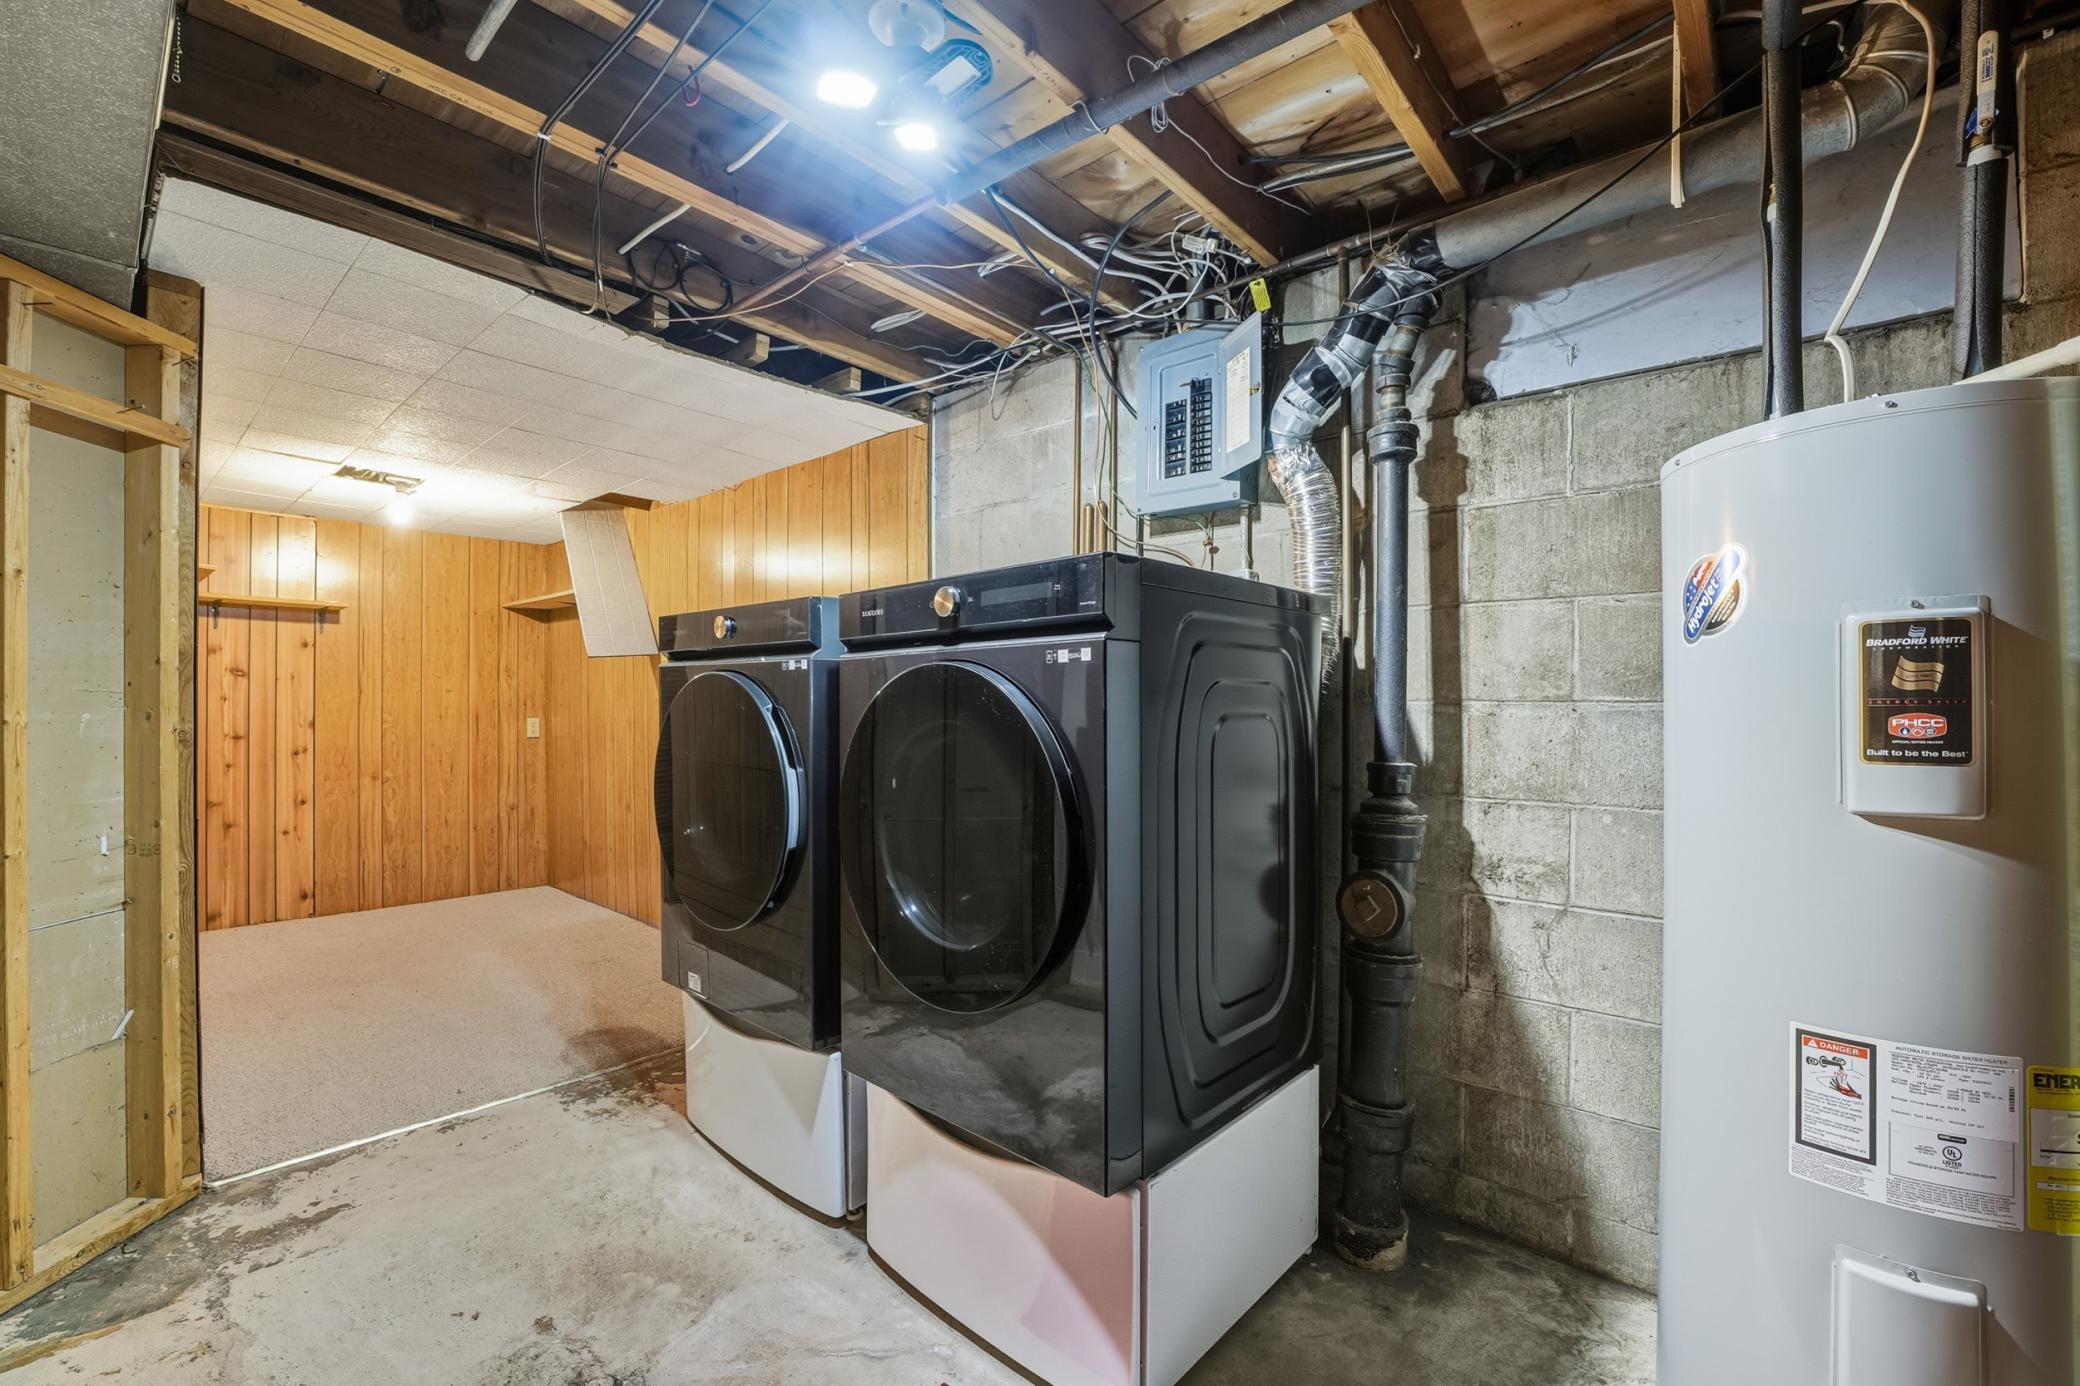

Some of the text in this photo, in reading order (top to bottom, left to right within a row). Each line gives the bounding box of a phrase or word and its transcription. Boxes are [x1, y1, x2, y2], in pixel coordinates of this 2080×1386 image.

[1687, 577, 1719, 633] Hydrojet
[1866, 636, 1968, 647] BRADFORD WHITE
[1892, 718, 1944, 727] PHCC
[1866, 748, 1889, 756] Built
[1891, 749, 1903, 757] to
[1905, 749, 1919, 757] be
[1921, 749, 1939, 757] the
[1820, 1041, 1859, 1056] DANGER
